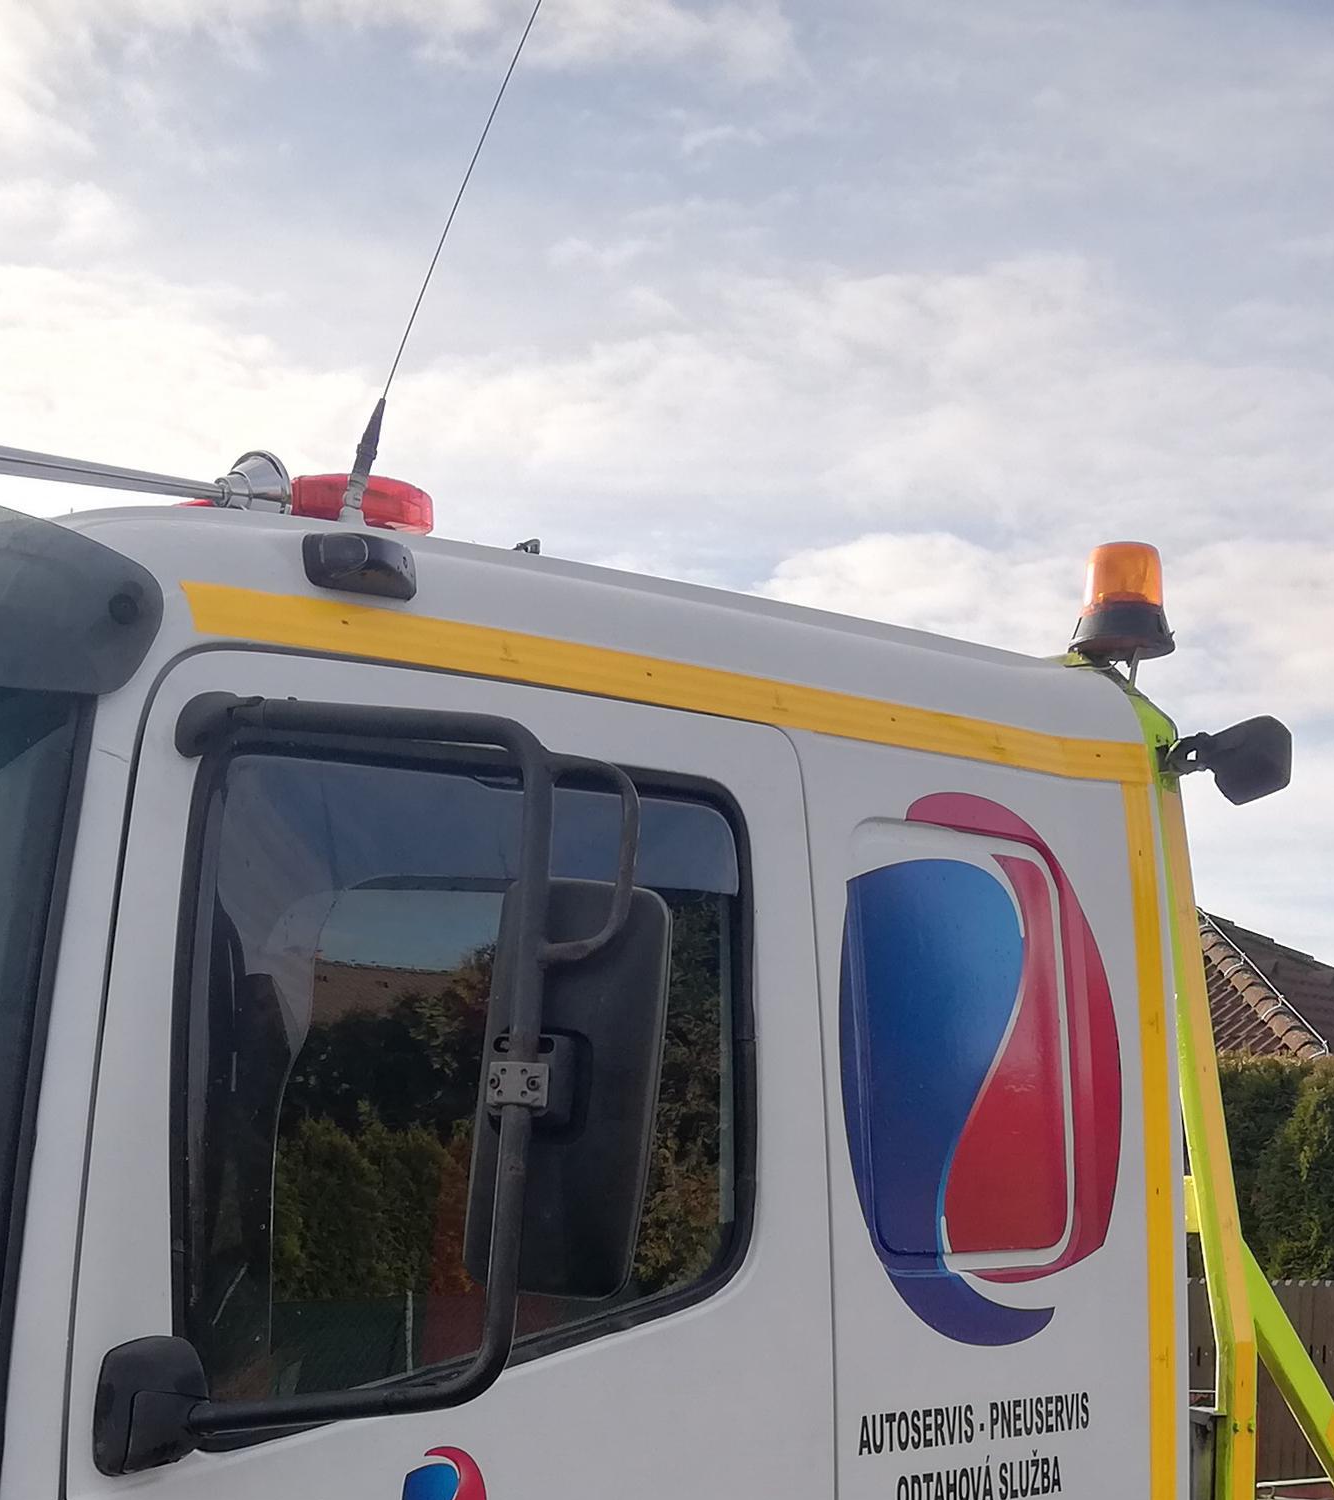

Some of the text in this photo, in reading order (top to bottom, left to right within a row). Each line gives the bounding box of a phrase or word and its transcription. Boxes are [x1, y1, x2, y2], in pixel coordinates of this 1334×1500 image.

[858, 1404, 974, 1456] AUTOSERVIS
[989, 1392, 1089, 1440] PNEUSERVIS
[999, 1450, 1061, 1500] SLUŽBA
